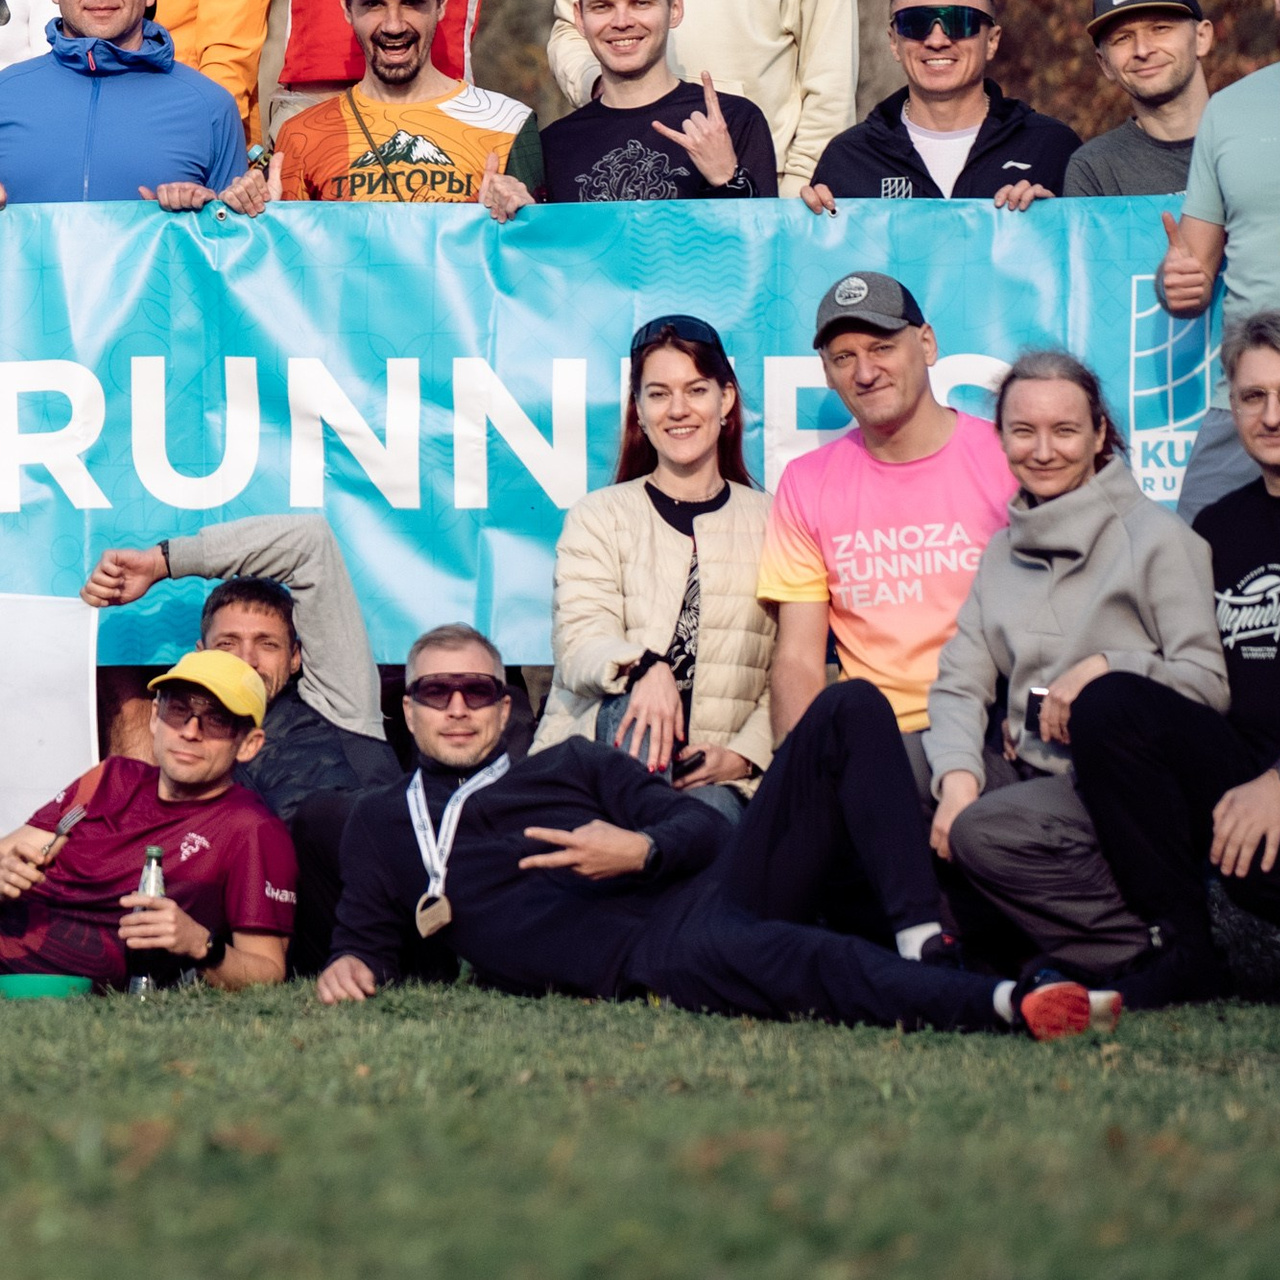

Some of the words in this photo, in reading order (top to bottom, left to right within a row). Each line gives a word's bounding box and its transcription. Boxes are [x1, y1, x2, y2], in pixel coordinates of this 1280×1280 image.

[331, 169, 473, 198] ТРИГОРЫ
[832, 522, 971, 560] ZANOZA
[836, 547, 983, 585] RUNNING
[836, 579, 924, 609] TEAM
